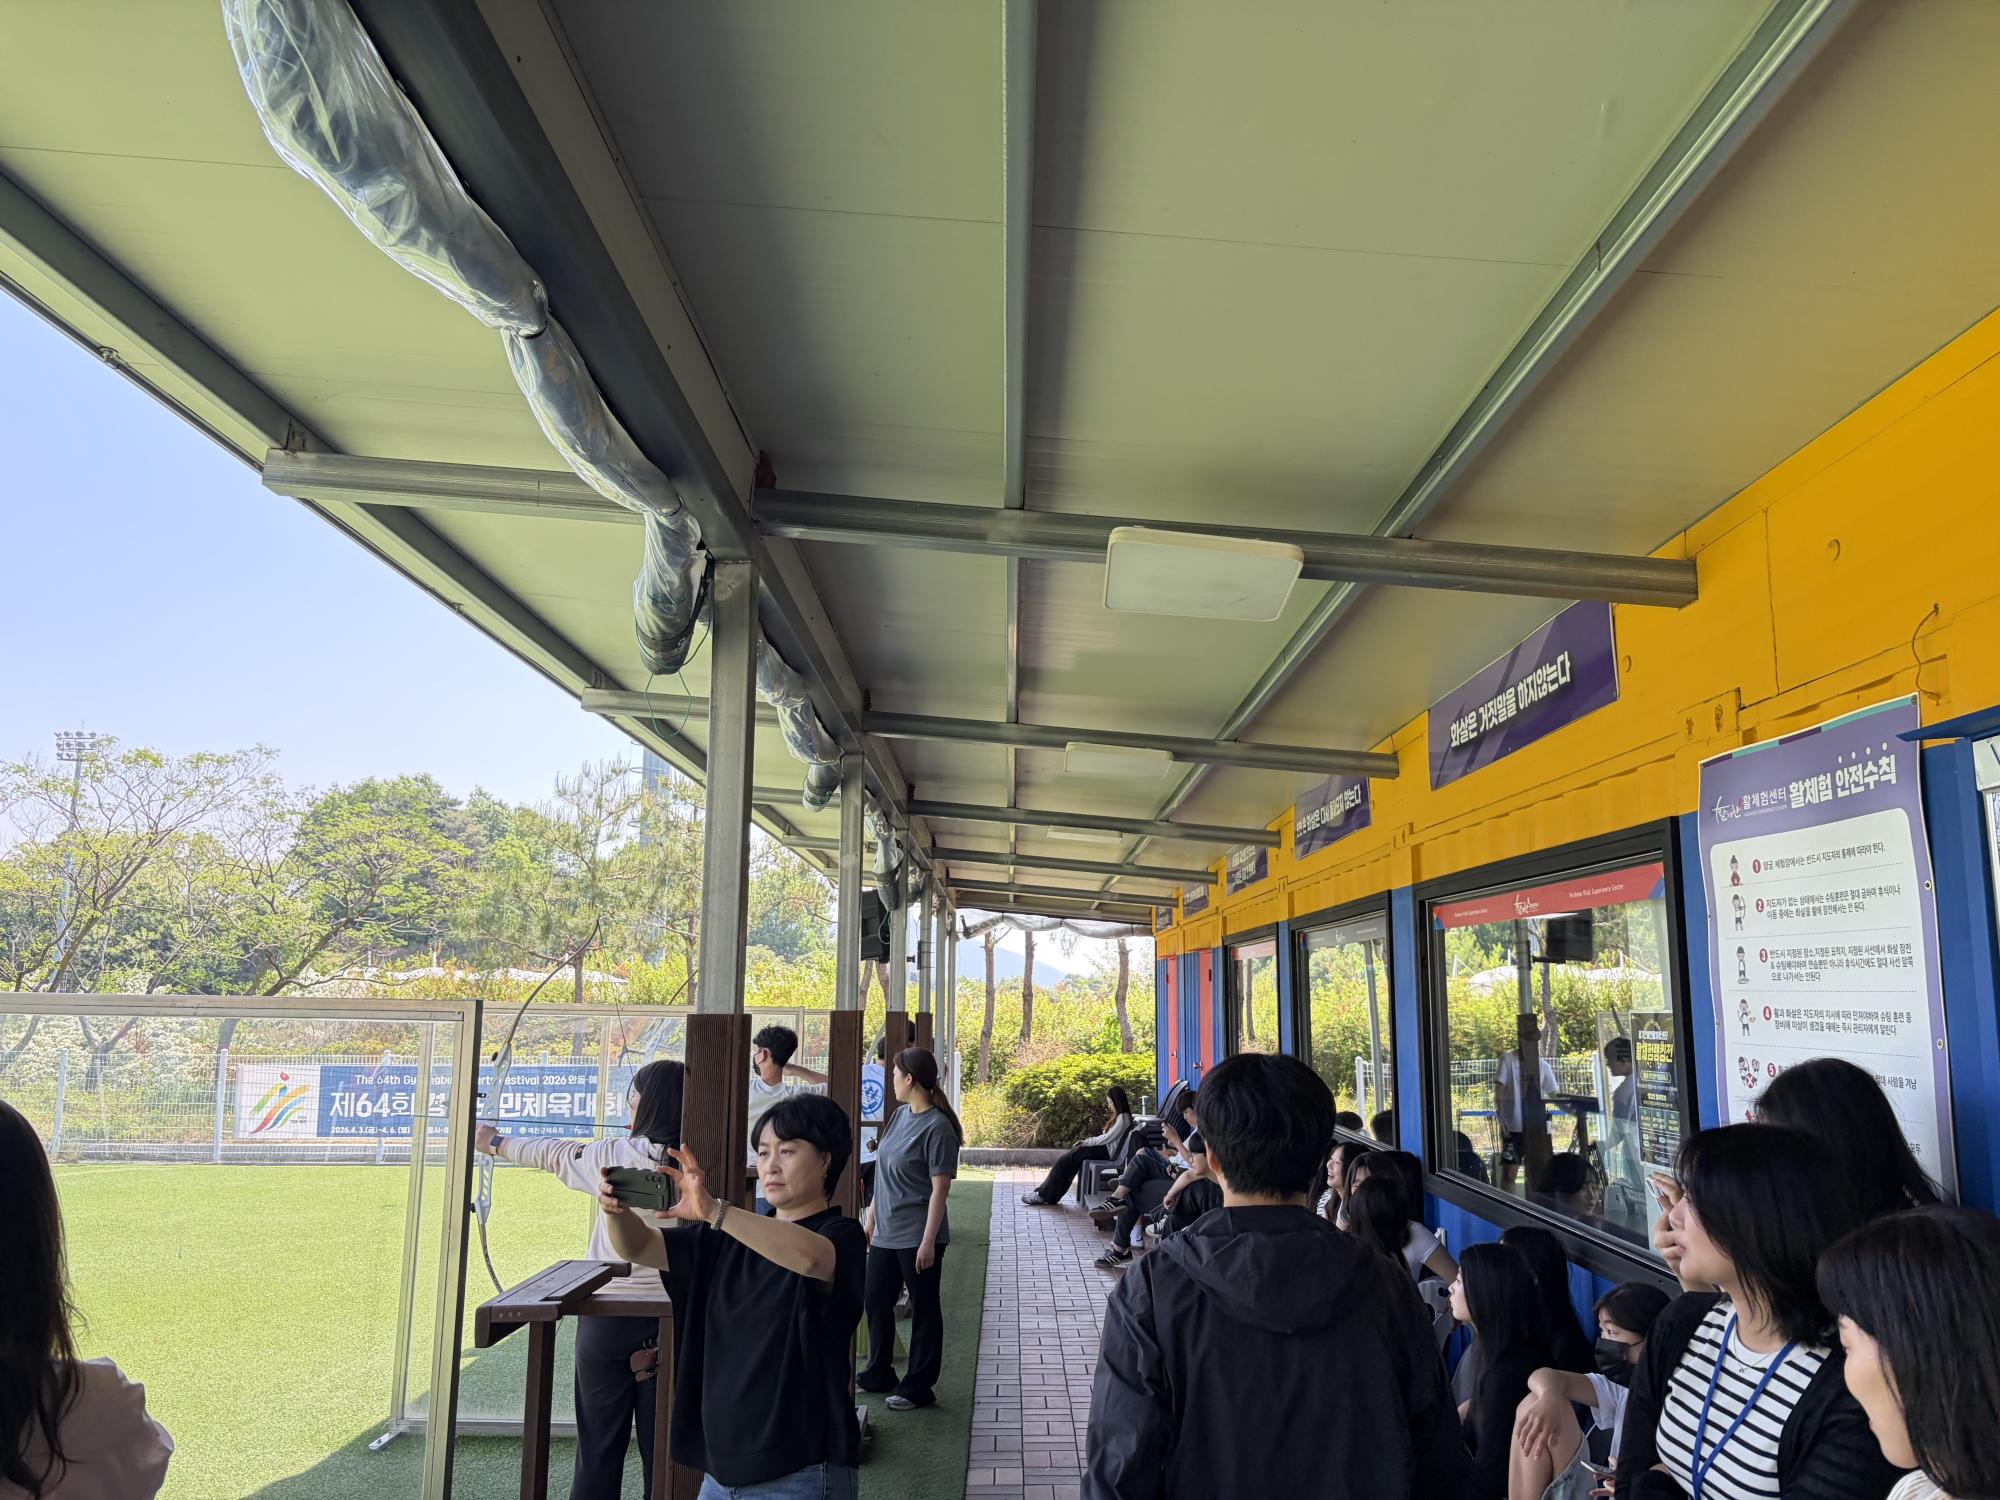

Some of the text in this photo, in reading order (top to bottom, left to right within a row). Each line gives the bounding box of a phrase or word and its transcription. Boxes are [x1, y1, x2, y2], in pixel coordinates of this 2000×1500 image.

[1450, 650, 1571, 749] 화살은 거짓말을 하지않는다
[1743, 787, 1787, 810] 활체험센터
[1789, 773, 1833, 809] 활체험
[1836, 754, 1897, 798] 안전수칙
[1806, 853, 1821, 865] 반드시
[1822, 849, 1841, 862] 지도자의
[1766, 897, 1787, 909] 지도자가
[1788, 896, 1799, 906] 없는
[1799, 893, 1825, 906] 상태에서는
[1878, 884, 1901, 897] 휴식이나
[1767, 909, 1778, 920] 이동
[1778, 907, 1795, 919] 중에는
[1795, 906, 1811, 918] 화살을
[1848, 902, 1853, 913] 안
[1770, 948, 1786, 959] 반드시
[1787, 947, 1802, 958] 지정된
[1848, 945, 1864, 957] 지정된
[1829, 958, 1844, 969] 아니라
[1845, 956, 1876, 969] 휴식시간에도
[1877, 956, 1888, 968] 절대
[1889, 956, 1901, 968] 사선
[1771, 972, 1782, 981] 으로
[1783, 971, 1804, 982] 나가서는
[1786, 1008, 1802, 1020] 화살은
[1803, 1009, 1825, 1020] 지도자의
[1825, 1009, 1841, 1020] 지시에
[1841, 1010, 1852, 1020] 따라
[1880, 1011, 1892, 1023] 슈팅
[1893, 1011, 1905, 1023] 훈련
[1906, 1011, 1912, 1024] 중
[1774, 1020, 1791, 1031] 장비에
[1791, 1021, 1808, 1032] 이상이
[1842, 1023, 1852, 1034] 즉시
[1853, 1023, 1879, 1035] 관리자에게
[355, 1074, 374, 1085] The
[376, 1074, 401, 1085] 64th
[543, 1075, 567, 1086] 2026
[1887, 1075, 1904, 1089] 사람을
[329, 1092, 414, 1118] 제64회
